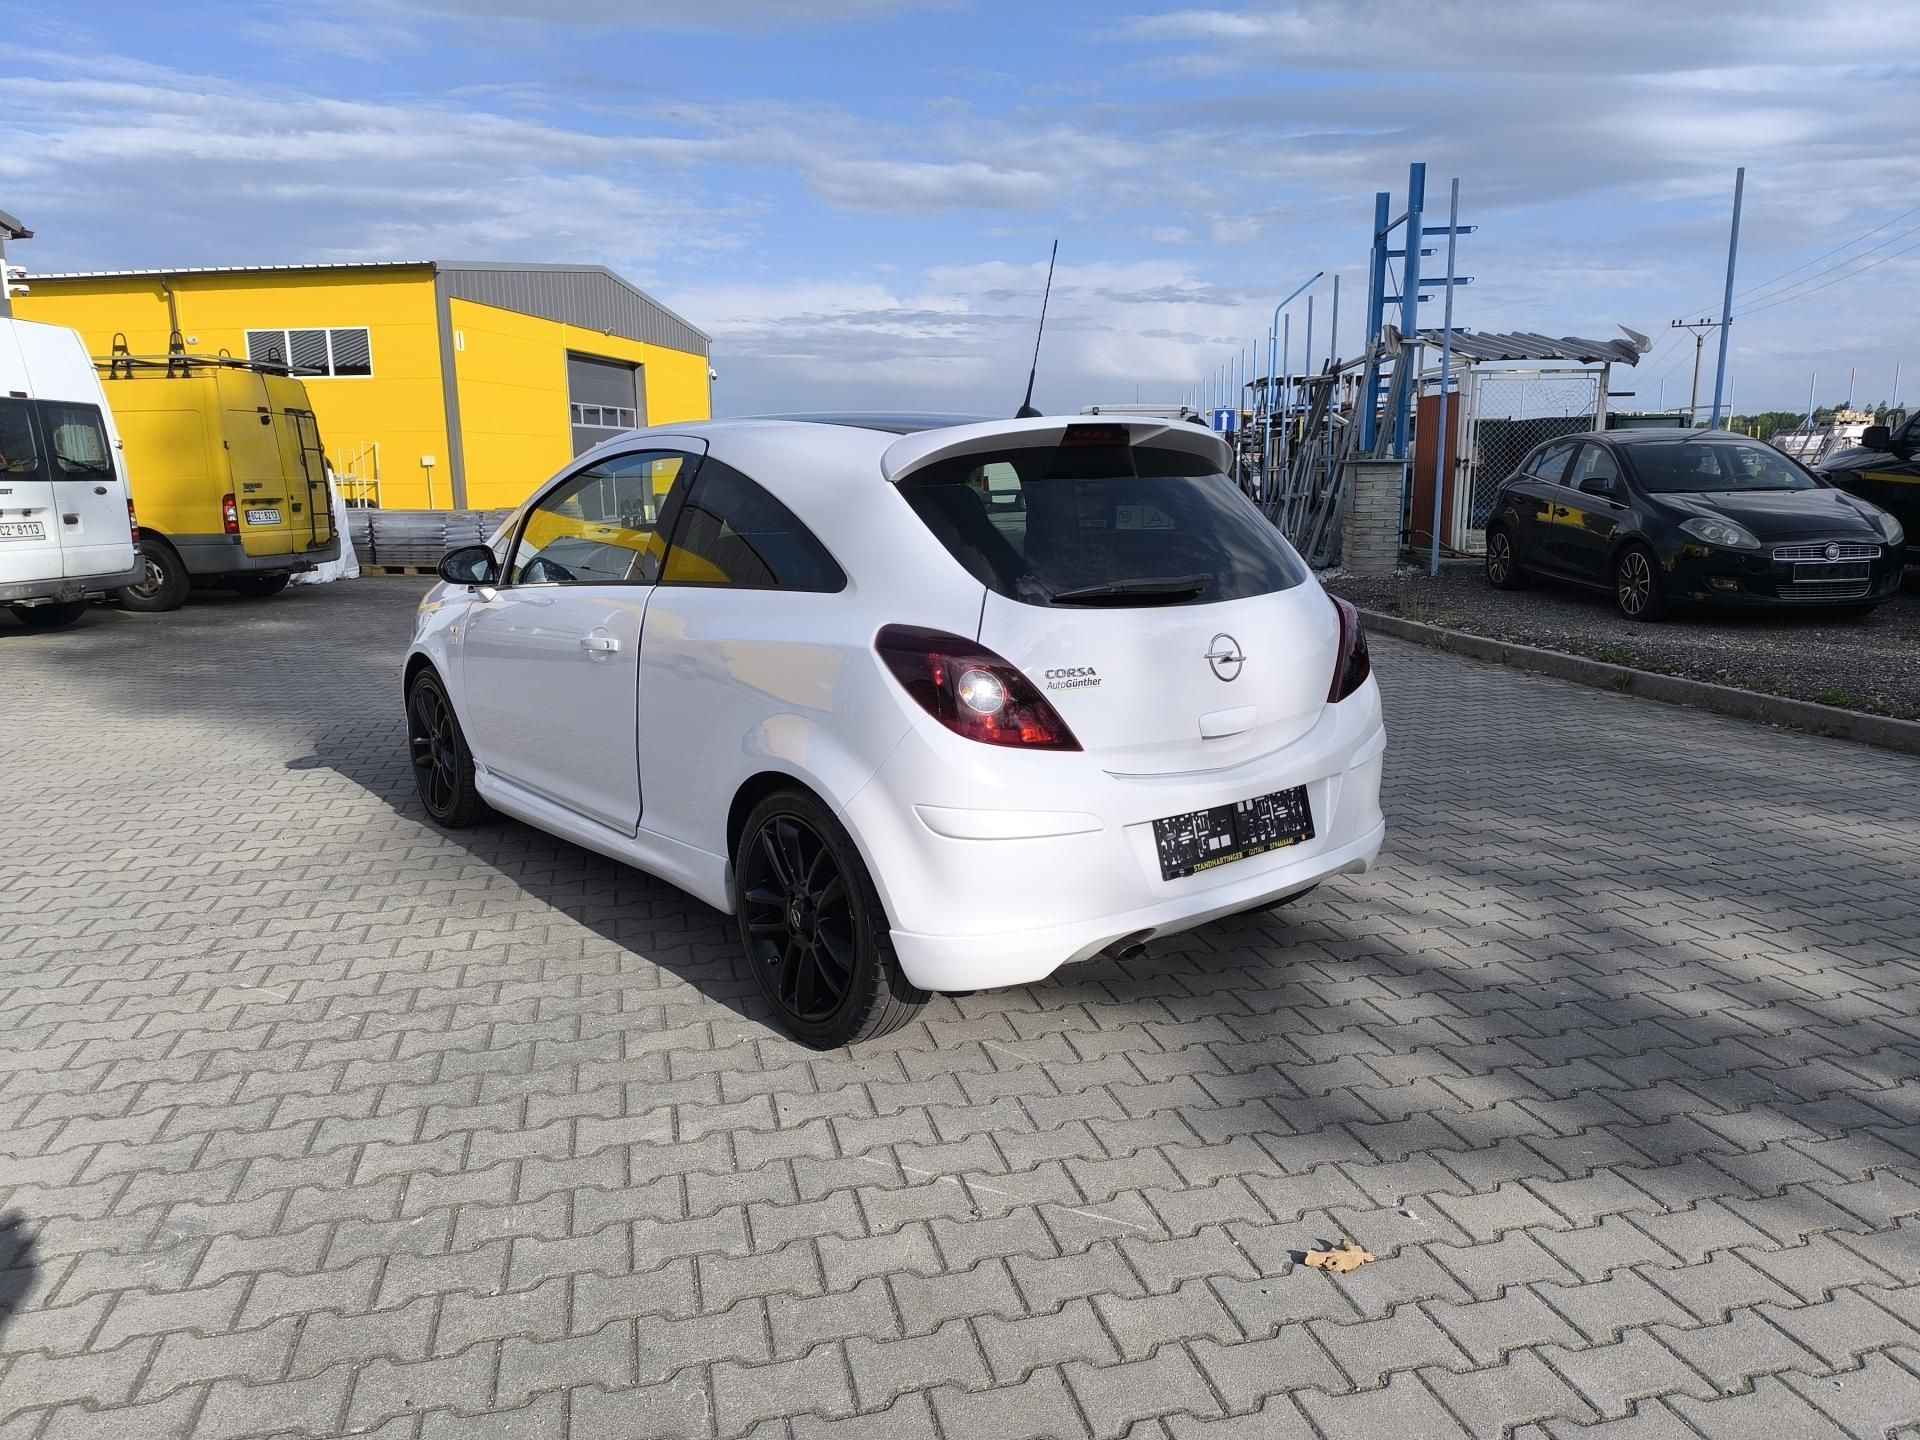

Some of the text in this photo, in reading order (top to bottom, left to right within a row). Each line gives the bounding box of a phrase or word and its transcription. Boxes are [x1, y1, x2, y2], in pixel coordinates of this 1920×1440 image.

[0, 524, 40, 536] C2 8113
[1045, 667, 1097, 679] CORSA
[1046, 677, 1102, 690] AutoGünther
[1193, 851, 1244, 872] STANDHARTINGER
